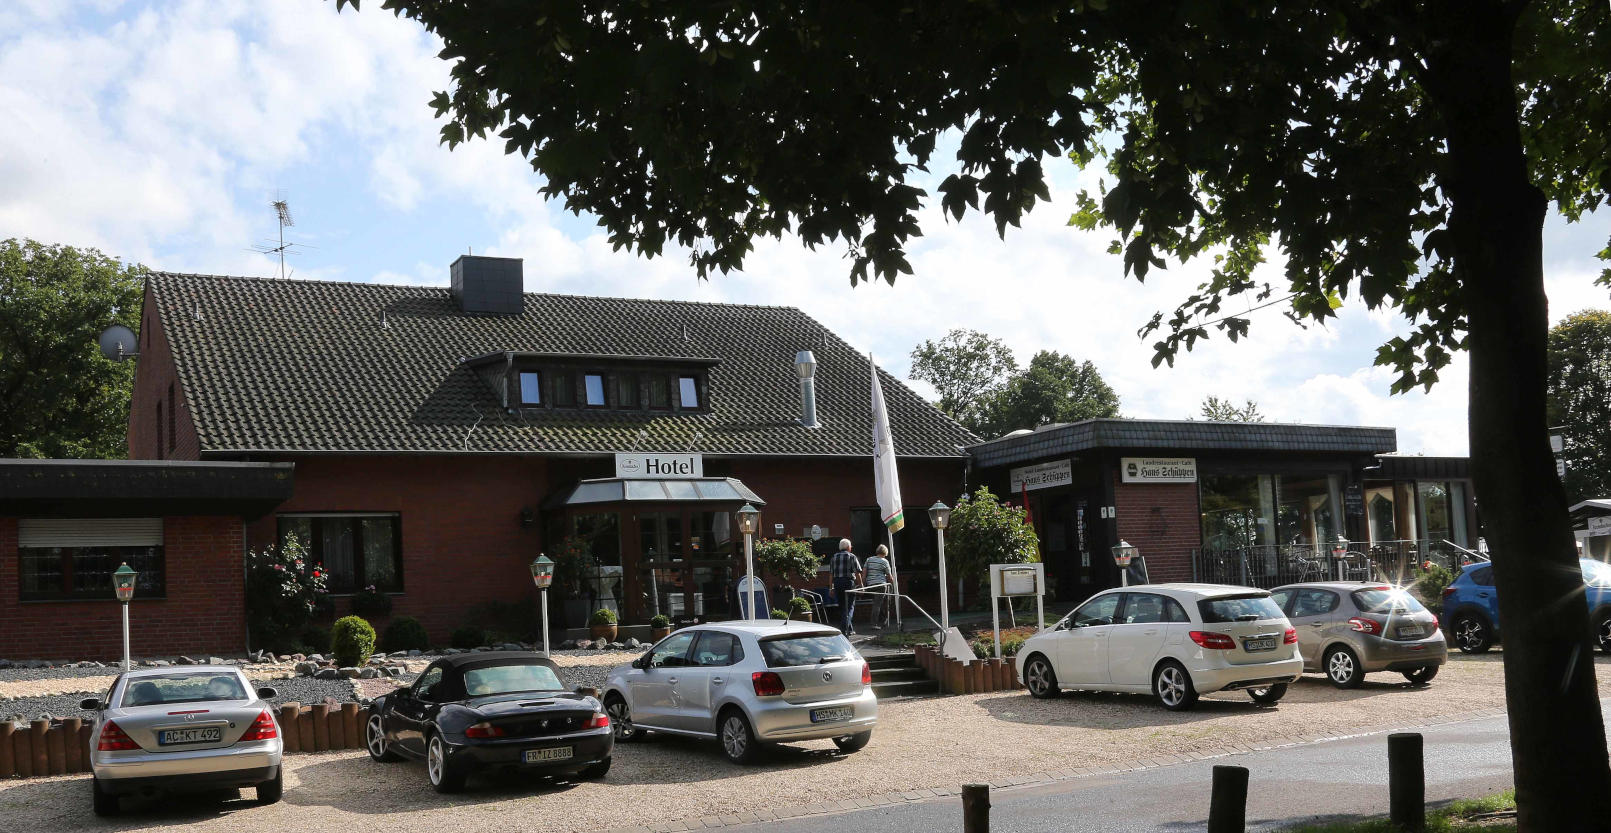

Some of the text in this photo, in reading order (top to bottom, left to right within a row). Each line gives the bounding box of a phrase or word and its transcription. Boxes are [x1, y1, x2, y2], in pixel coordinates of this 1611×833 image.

[645, 457, 695, 475] Hotel
[1141, 467, 1160, 478] Haus
[815, 710, 826, 719] HS
[166, 729, 219, 742] AC KT 492
[527, 751, 537, 761] FR
